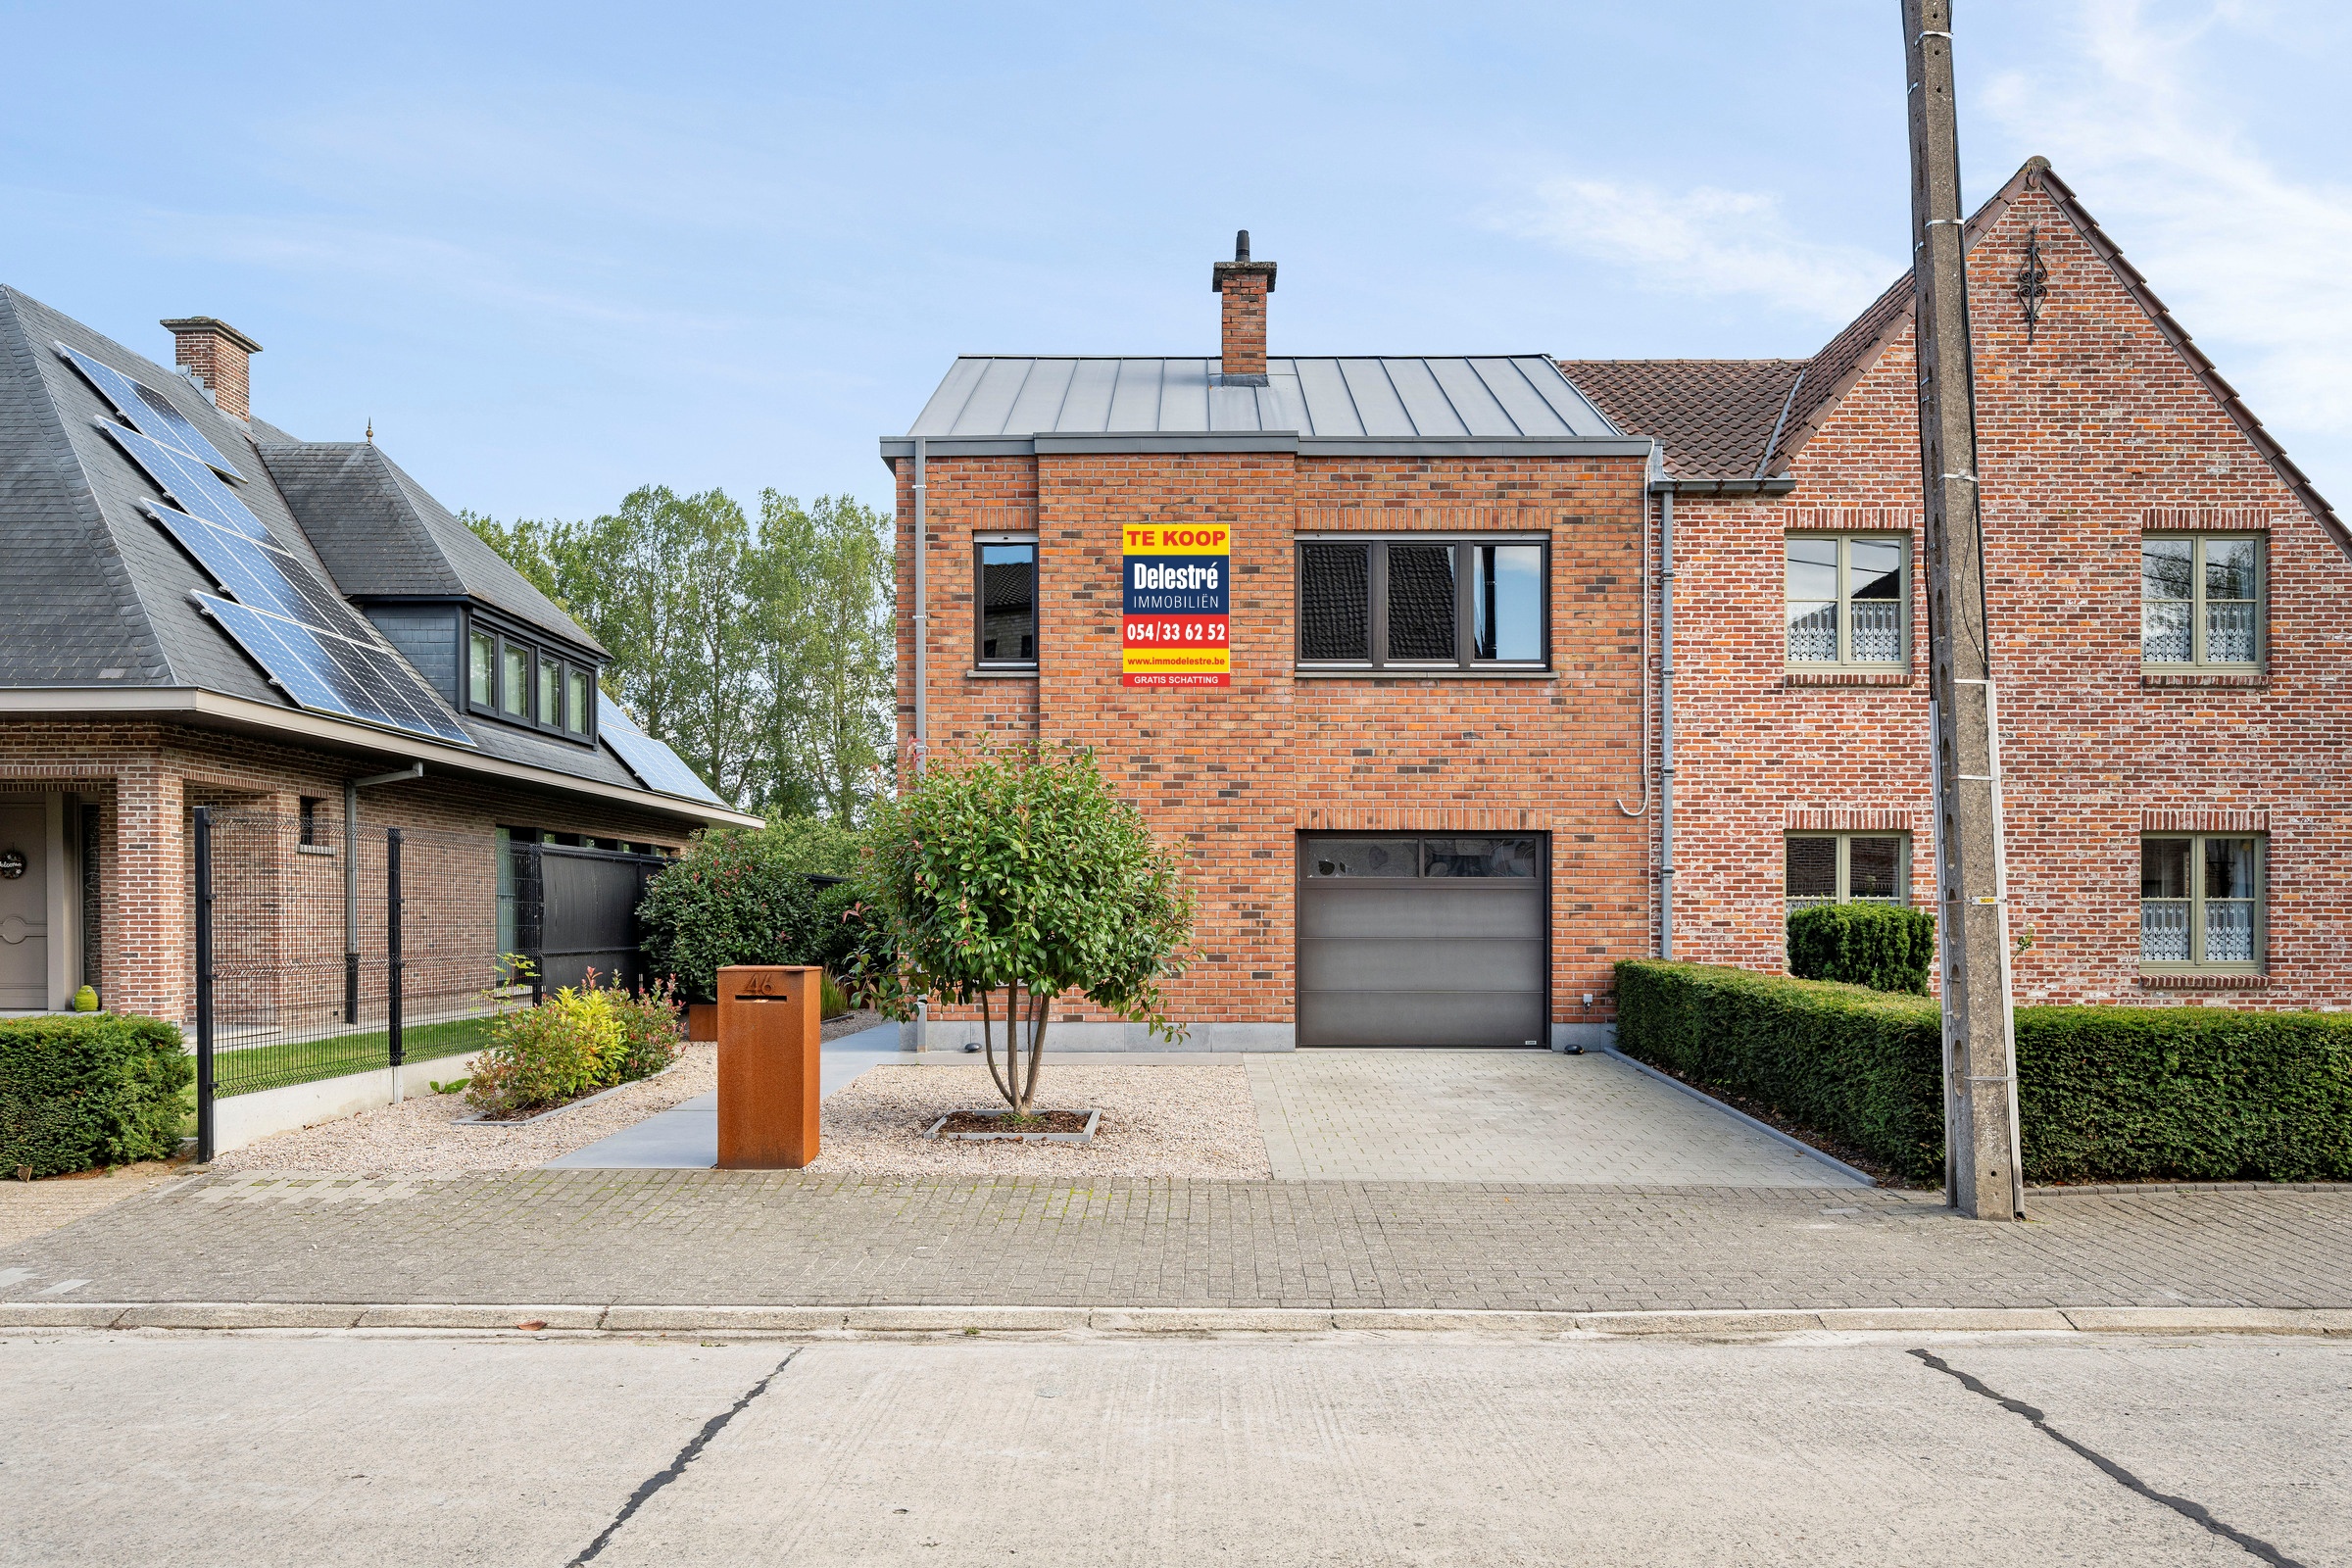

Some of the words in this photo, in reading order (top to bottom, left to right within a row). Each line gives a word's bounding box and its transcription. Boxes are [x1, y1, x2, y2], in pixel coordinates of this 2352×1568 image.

[1127, 530, 1155, 546] TE
[1163, 530, 1226, 546] KOOP
[1134, 562, 1218, 590] Delestré
[1133, 594, 1219, 609] IMMOBILIËN
[1127, 621, 1180, 642] 054/33
[1185, 623, 1203, 641] 62
[1207, 623, 1225, 641] 52
[1127, 657, 1225, 665] www.immodelestre.be
[1134, 675, 1166, 684] GRATIS
[1168, 675, 1219, 684] SCHATTING
[744, 972, 775, 996] 46
